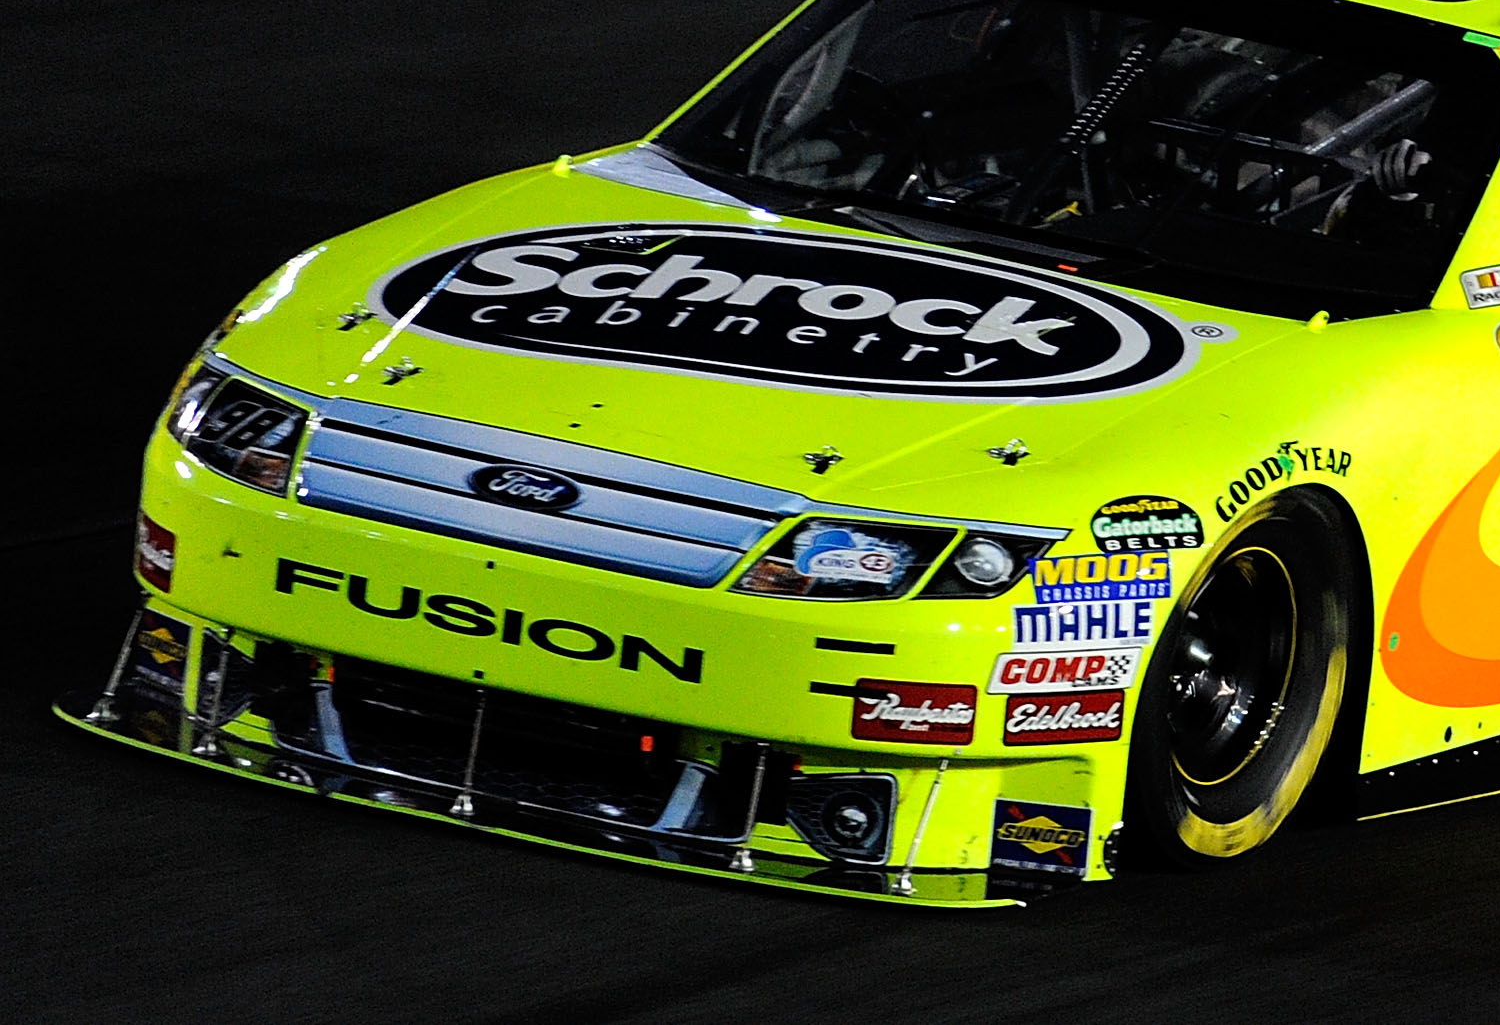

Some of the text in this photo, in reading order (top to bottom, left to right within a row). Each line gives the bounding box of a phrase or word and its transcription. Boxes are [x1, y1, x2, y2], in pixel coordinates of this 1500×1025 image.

[443, 243, 1075, 357] Schrock
[470, 299, 998, 379] cabinetry
[201, 400, 297, 452] 98
[487, 469, 564, 504] Ford
[1215, 439, 1352, 523] GOODYEAR
[1100, 498, 1180, 515] GOODYEAR
[1092, 514, 1198, 538] Gatorback
[1104, 536, 1198, 551] BELTS
[1034, 551, 1168, 586] MOOG
[1041, 582, 1167, 602] CHASSIS PARTS
[273, 556, 706, 685] FUSION
[1014, 601, 1151, 643] MAHLE
[1000, 654, 1106, 685] COMP
[1006, 702, 1121, 733] Edelbrock
[1002, 823, 1084, 847] SUNOCO
